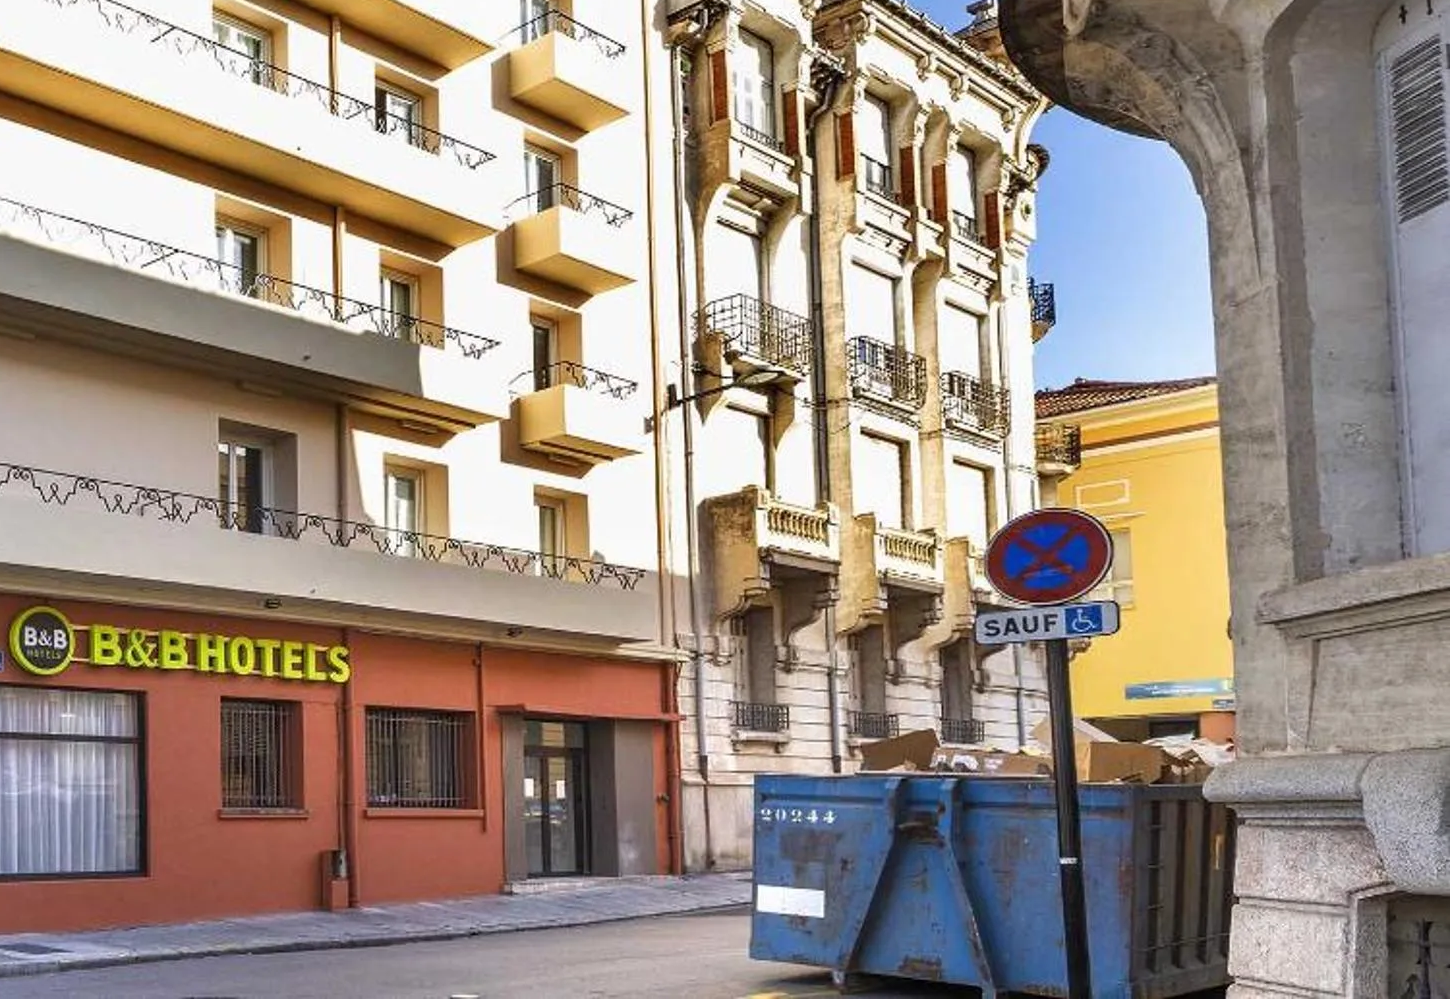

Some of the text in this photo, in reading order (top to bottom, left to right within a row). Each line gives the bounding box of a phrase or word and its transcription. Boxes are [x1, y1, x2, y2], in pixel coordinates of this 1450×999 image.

[24, 625, 68, 650] B&B
[984, 614, 1058, 637] SAUF
[91, 624, 351, 684] B&B HOTELS
[761, 808, 837, 824] 20244
